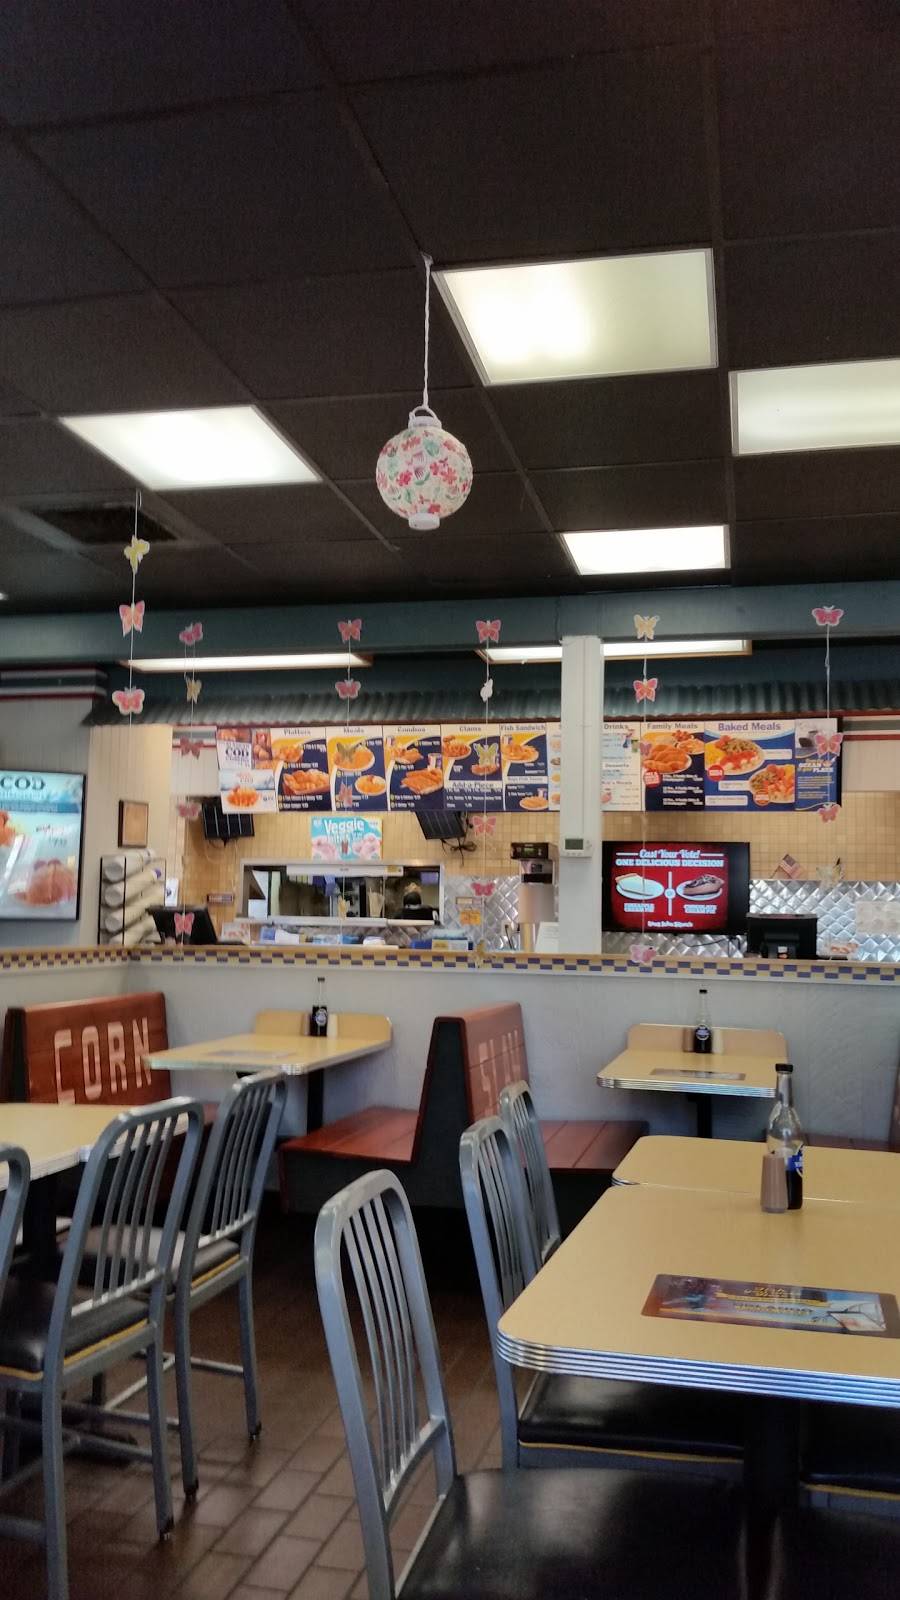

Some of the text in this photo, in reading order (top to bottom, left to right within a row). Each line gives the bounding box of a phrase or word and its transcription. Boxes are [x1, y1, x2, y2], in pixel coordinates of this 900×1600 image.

[516, 724, 546, 732] Sandwich
[603, 723, 630, 731] Drinks
[647, 723, 672, 731] Family
[718, 722, 782, 732] Baked Meals
[283, 728, 311, 736] Platters
[225, 748, 249, 757] COD
[0, 776, 46, 791] COD
[323, 817, 365, 836] Veggie
[640, 849, 657, 858] Cast
[616, 858, 635, 866] ONE
[636, 859, 681, 867] DELICIOUS
[54, 1016, 152, 1105] CORN
